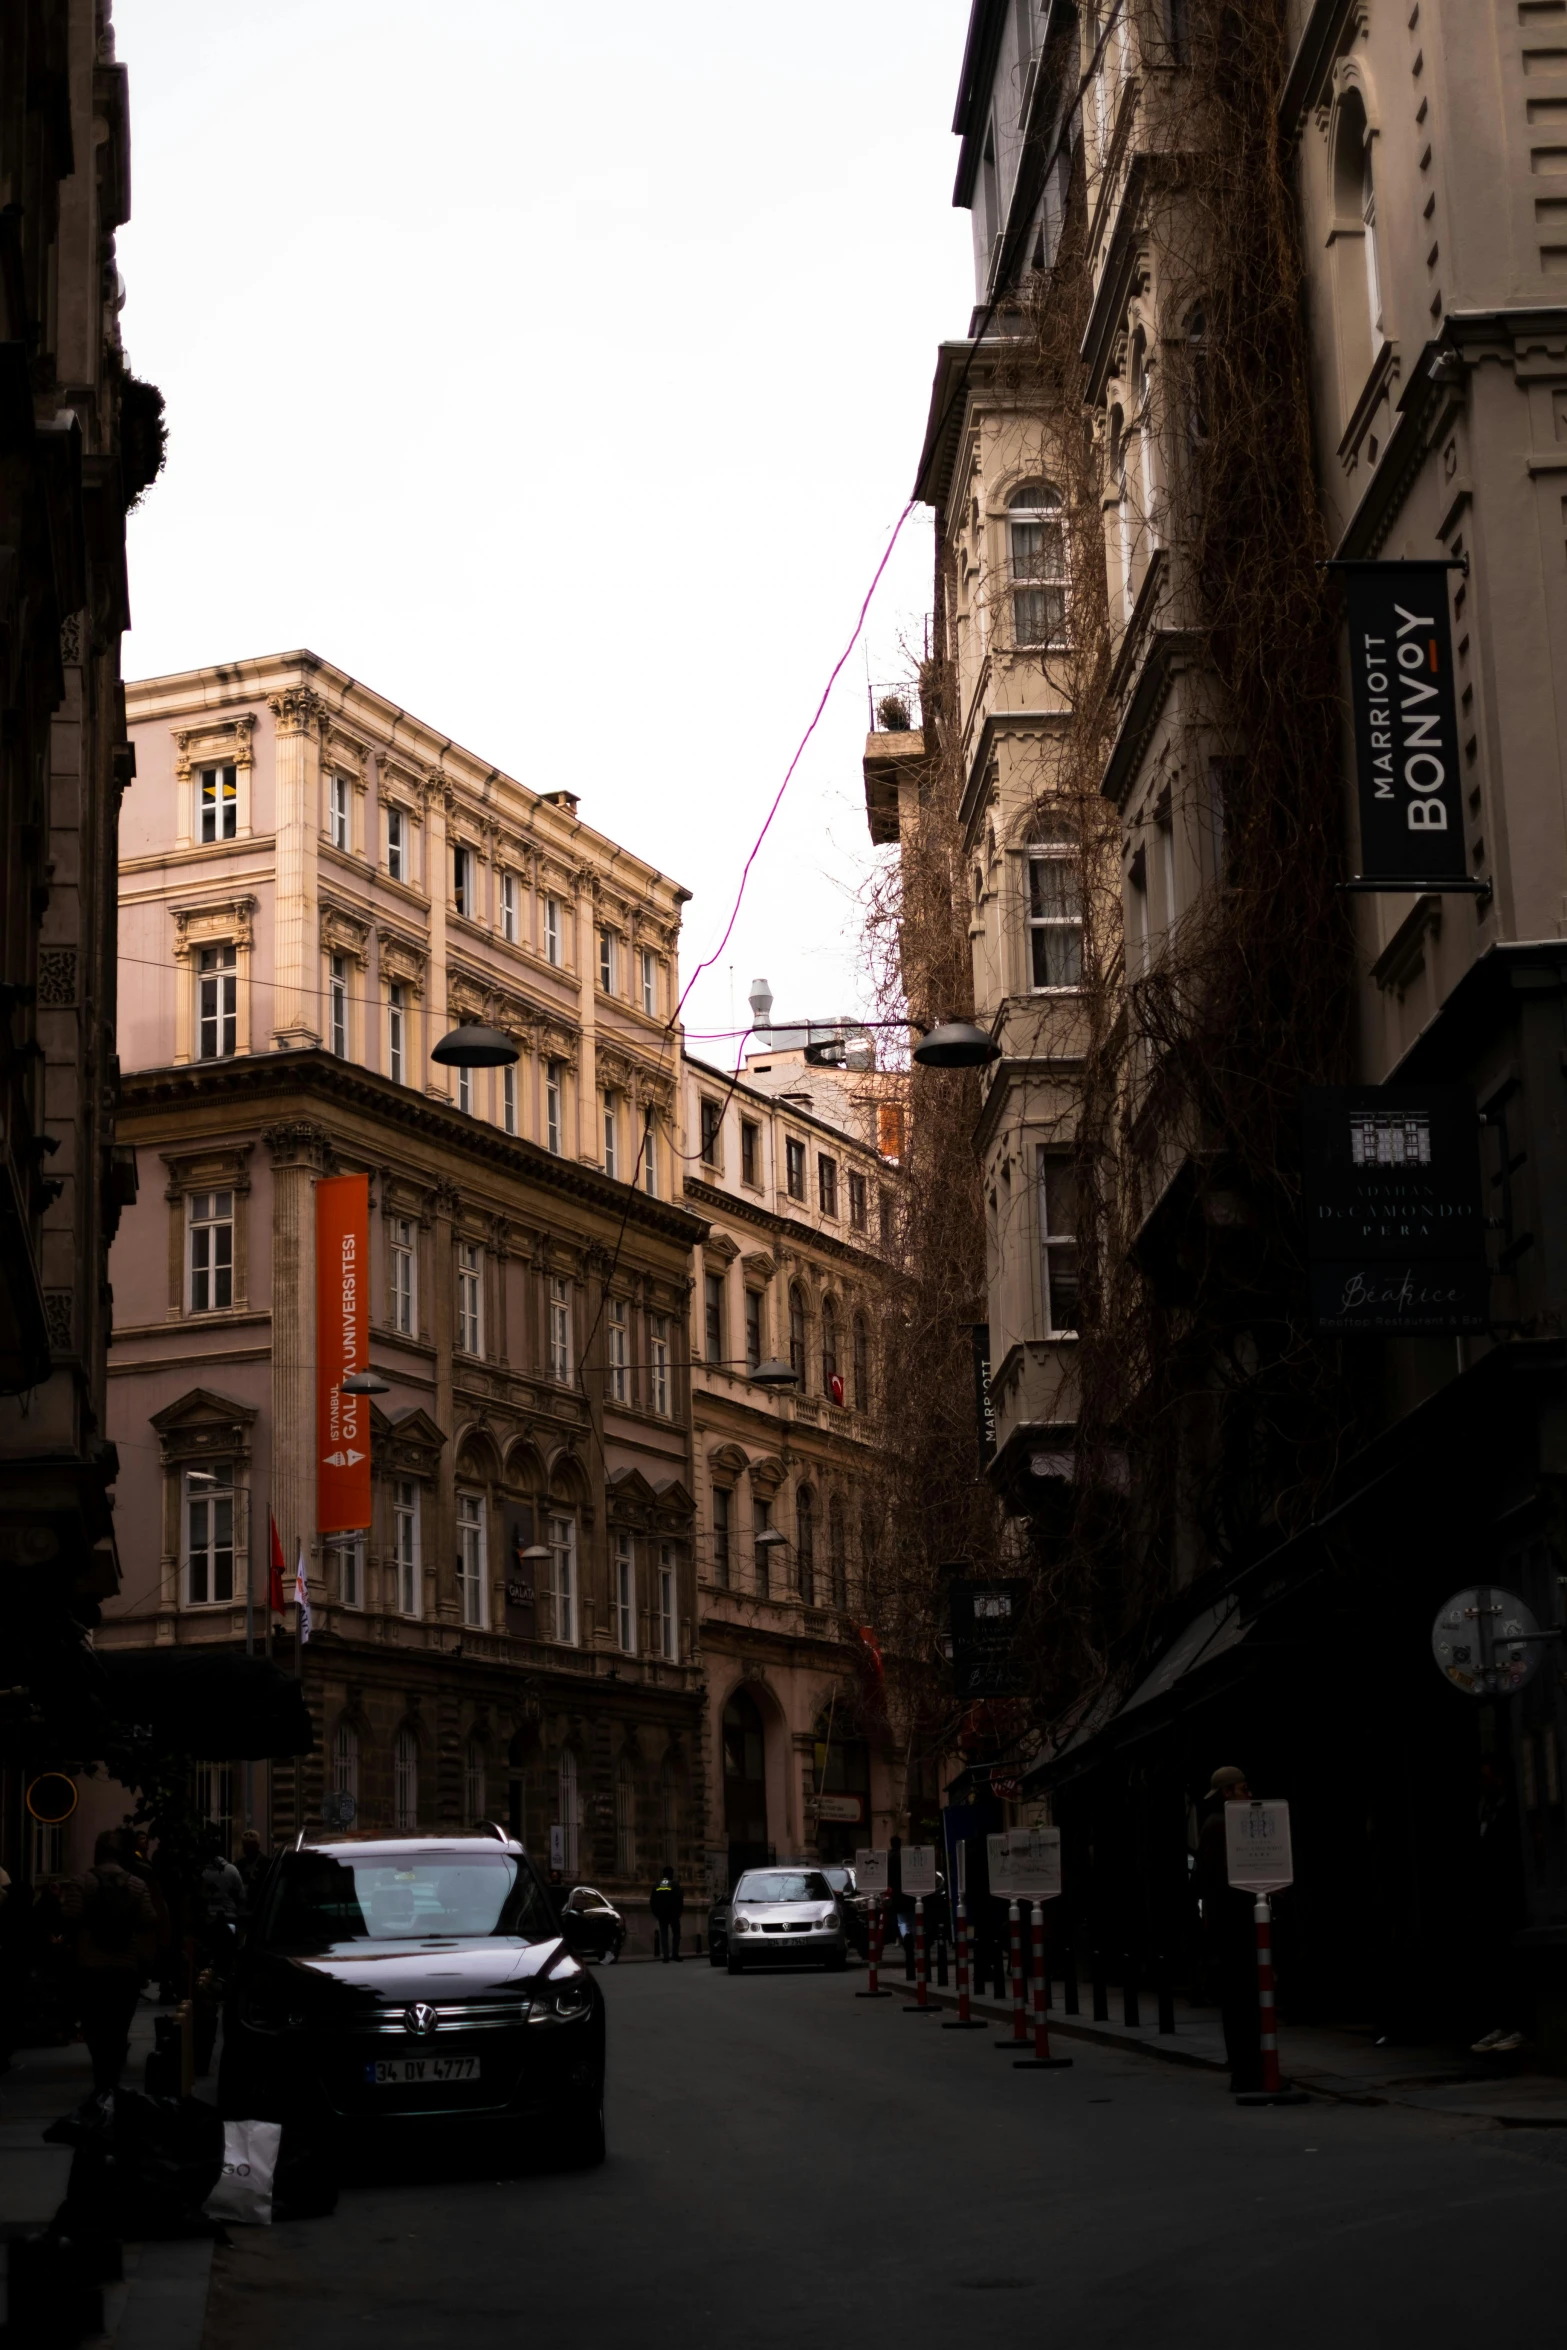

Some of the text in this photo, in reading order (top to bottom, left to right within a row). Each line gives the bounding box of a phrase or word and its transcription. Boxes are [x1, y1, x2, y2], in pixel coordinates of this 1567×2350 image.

[1364, 634, 1395, 800] MARRIOTT
[1393, 603, 1448, 831] BONVOY
[1356, 1185, 1435, 1197] ADAHAN
[1362, 1225, 1430, 1236] PERA
[1319, 1315, 1484, 1328] Rooftop Restaurant & Bar
[982, 1360, 996, 1441] MARROTT
[509, 1584, 534, 1600] GALATA
[377, 2063, 397, 2081] 34
[434, 2058, 474, 2079] 4777
